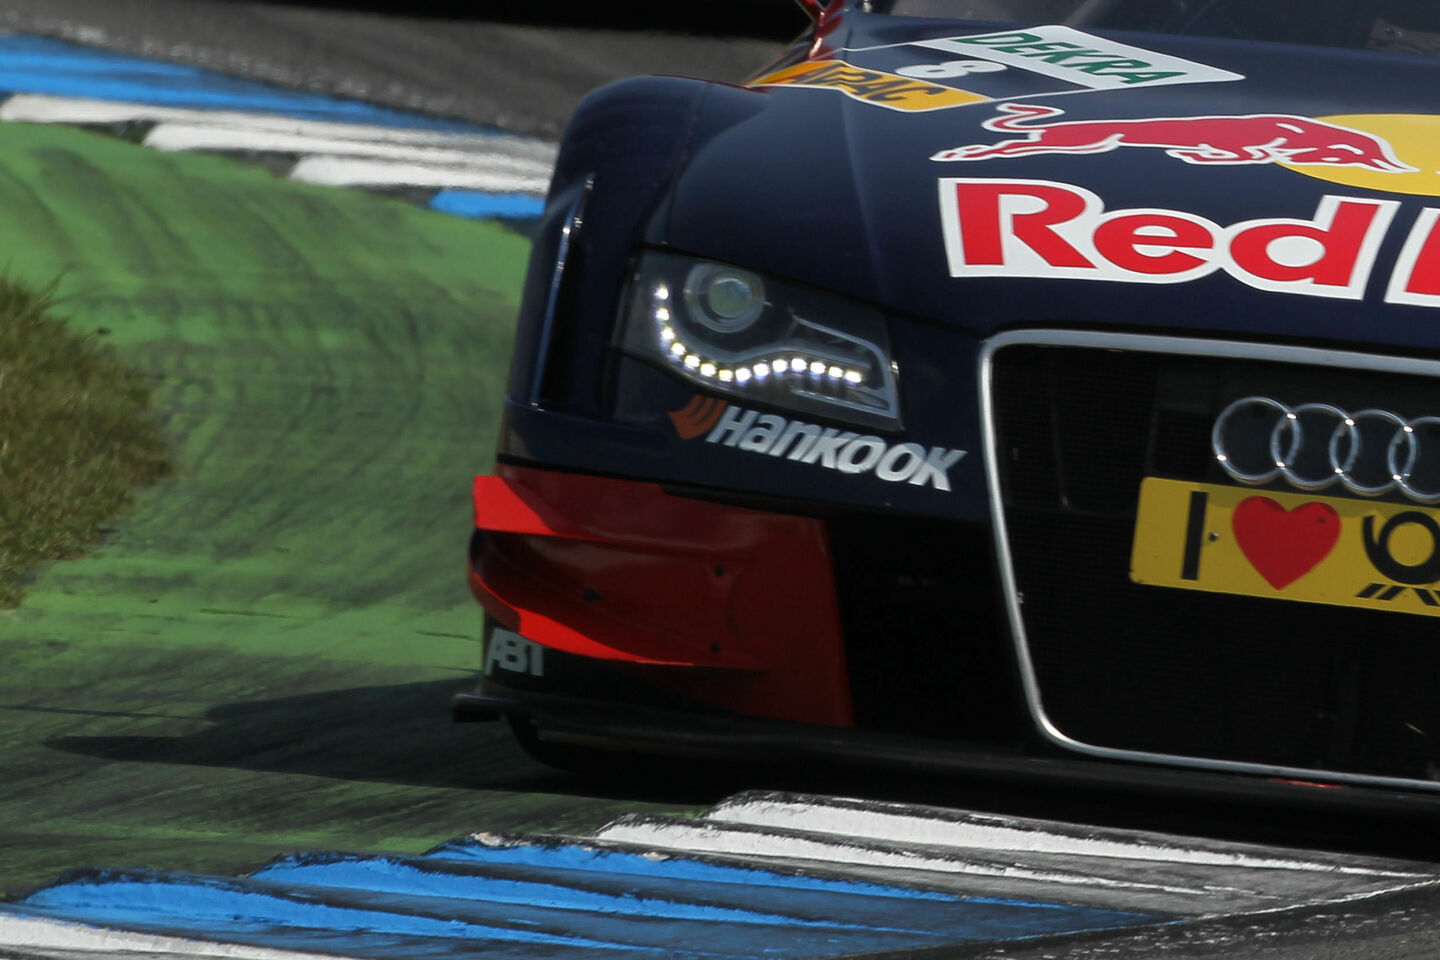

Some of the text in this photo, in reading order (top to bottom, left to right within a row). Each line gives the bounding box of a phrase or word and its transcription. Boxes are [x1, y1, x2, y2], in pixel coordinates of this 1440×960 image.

[950, 31, 1189, 85] DEKRA
[939, 178, 1400, 300] Red
[705, 405, 967, 492] Hankook
[1181, 490, 1208, 581] I
